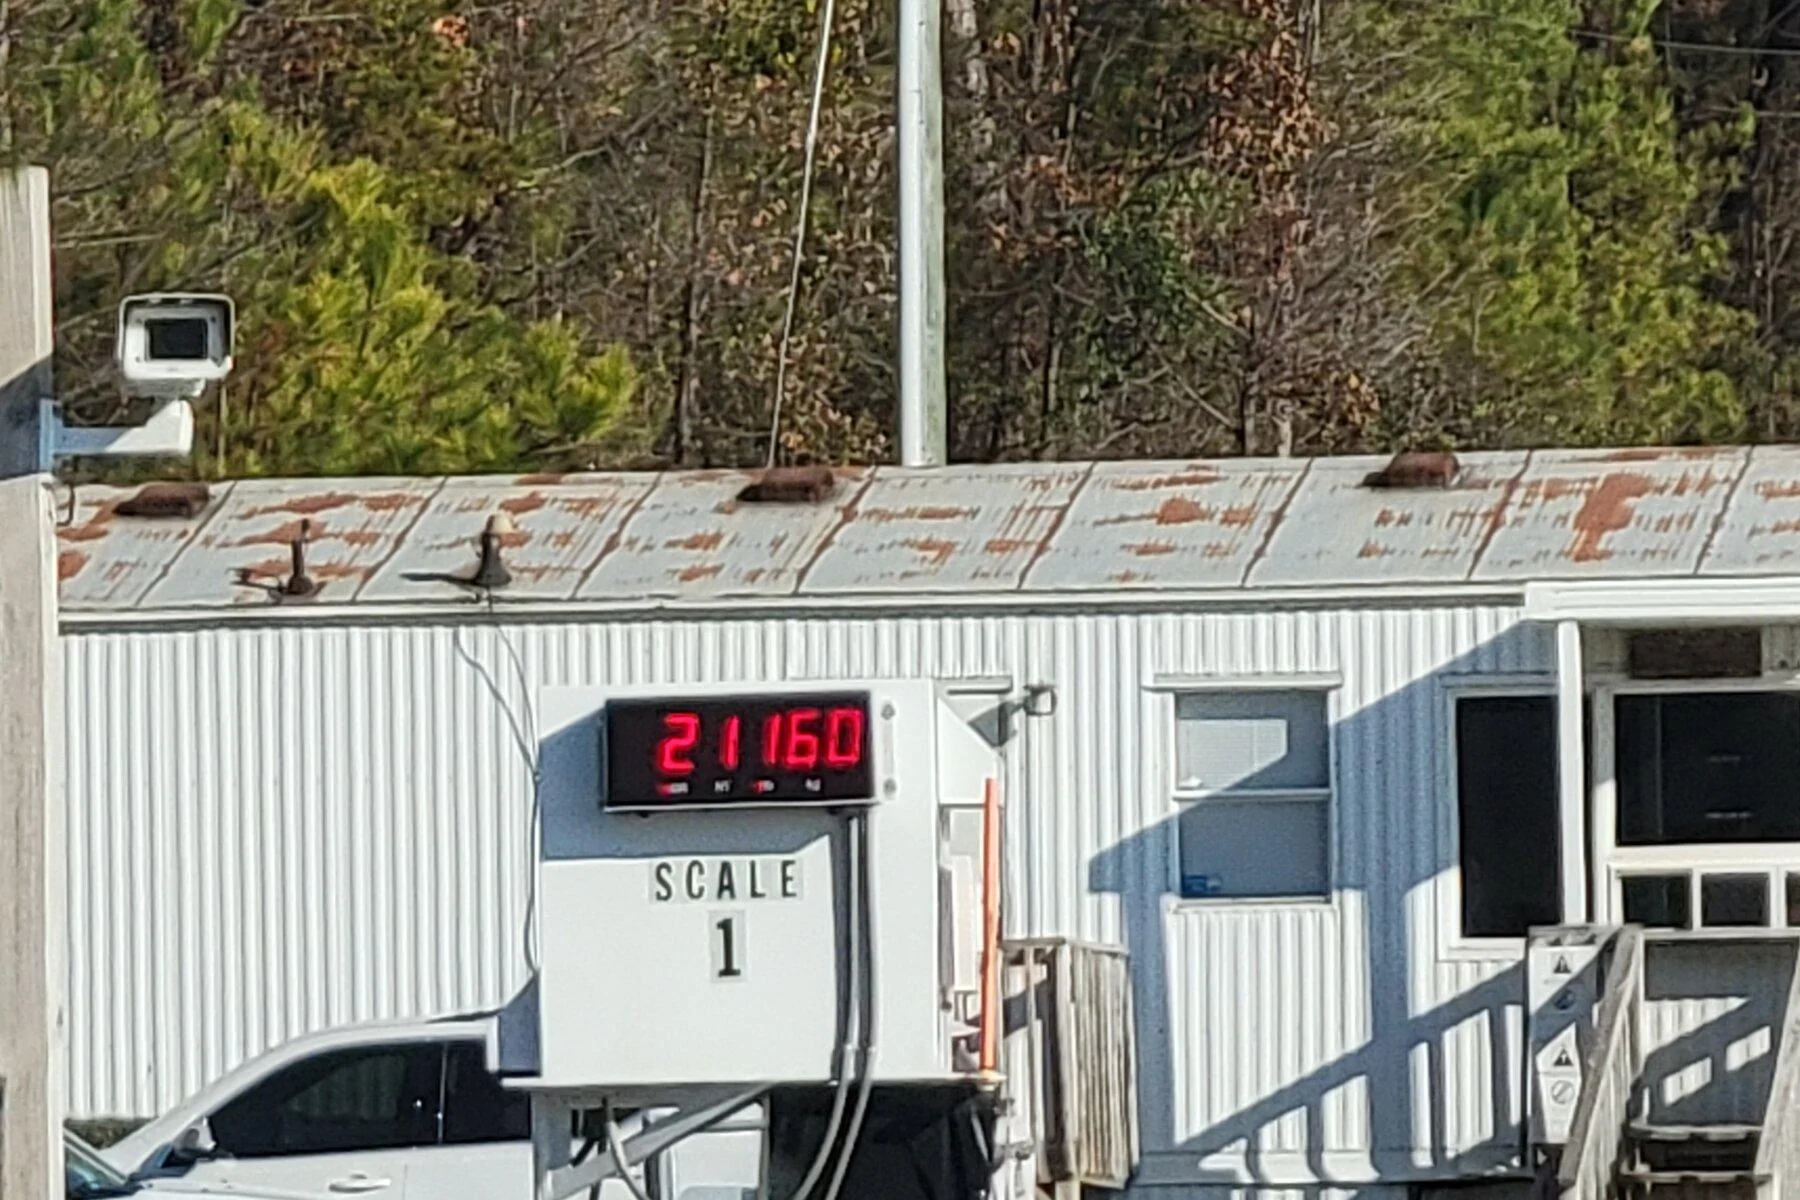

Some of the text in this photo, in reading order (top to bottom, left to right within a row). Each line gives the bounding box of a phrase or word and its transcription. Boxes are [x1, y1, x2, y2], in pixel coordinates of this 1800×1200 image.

[658, 708, 864, 773] 21160
[655, 859, 798, 901] SCALE
[716, 917, 742, 978] 1
